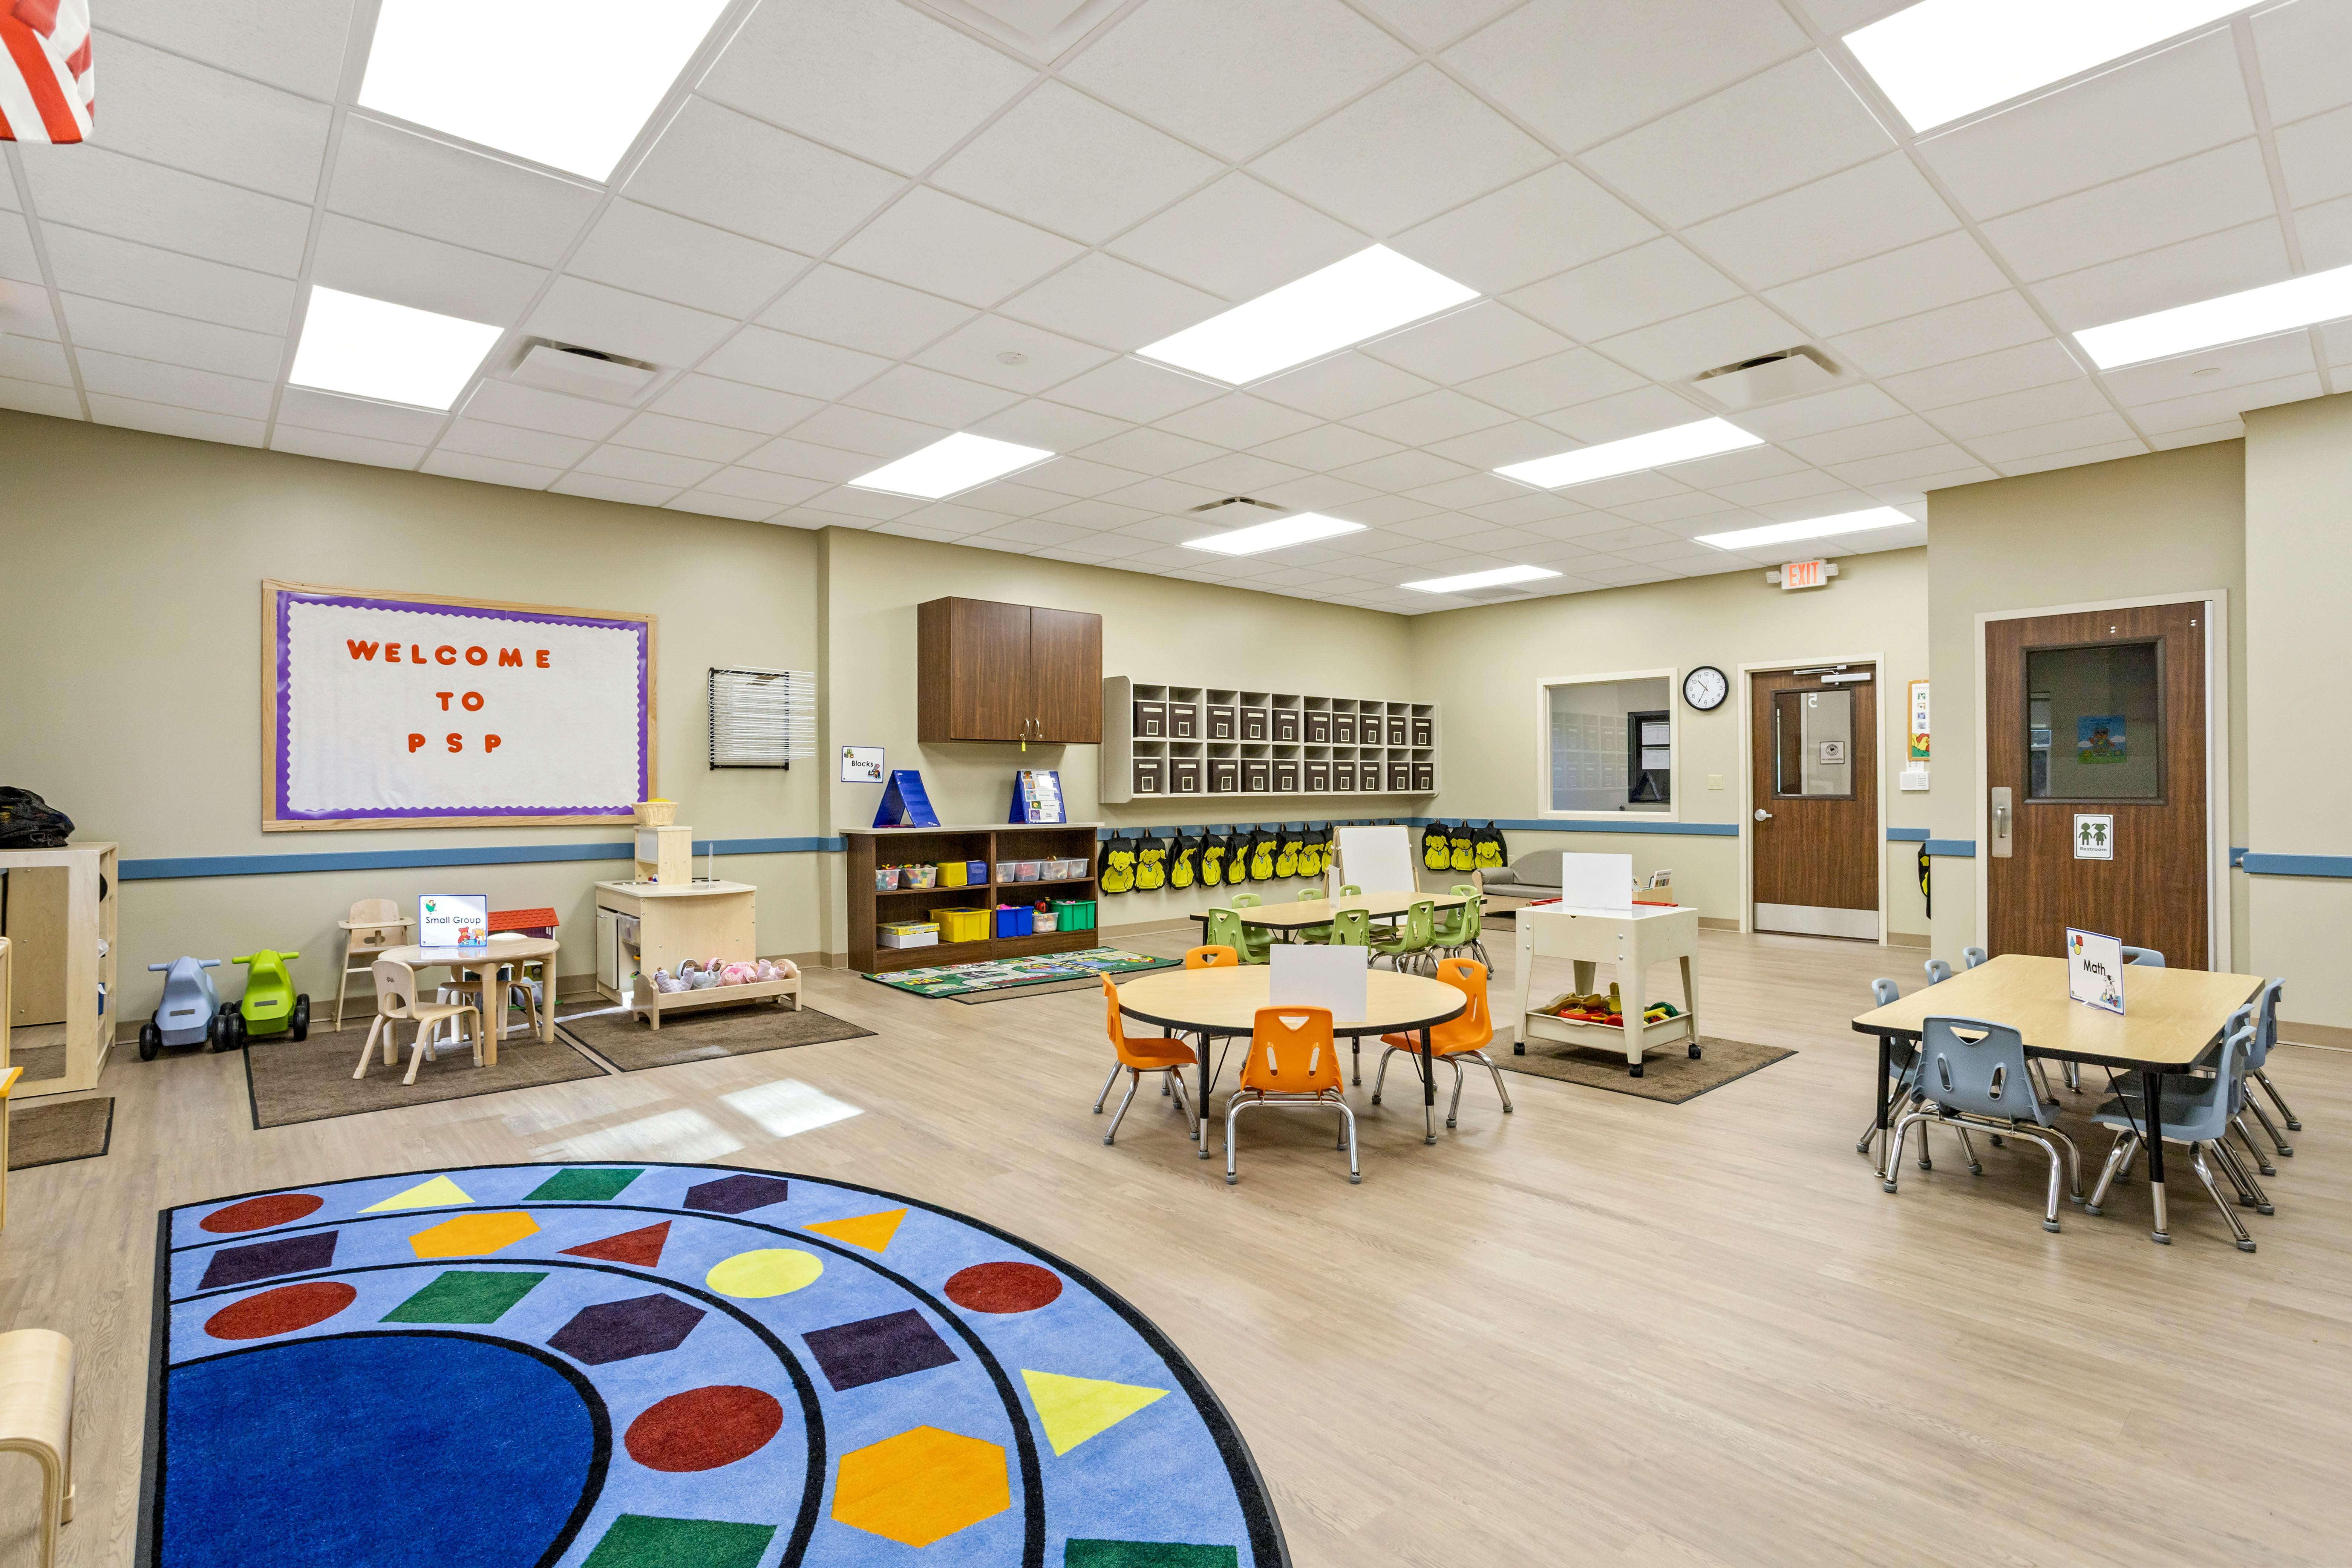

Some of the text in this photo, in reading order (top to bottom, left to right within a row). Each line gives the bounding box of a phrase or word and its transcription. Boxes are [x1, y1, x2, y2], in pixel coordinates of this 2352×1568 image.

[1789, 562, 1819, 586] EXIT
[346, 639, 551, 668] WELCOME
[436, 691, 484, 712] TO
[2084, 959, 2106, 976] Math
